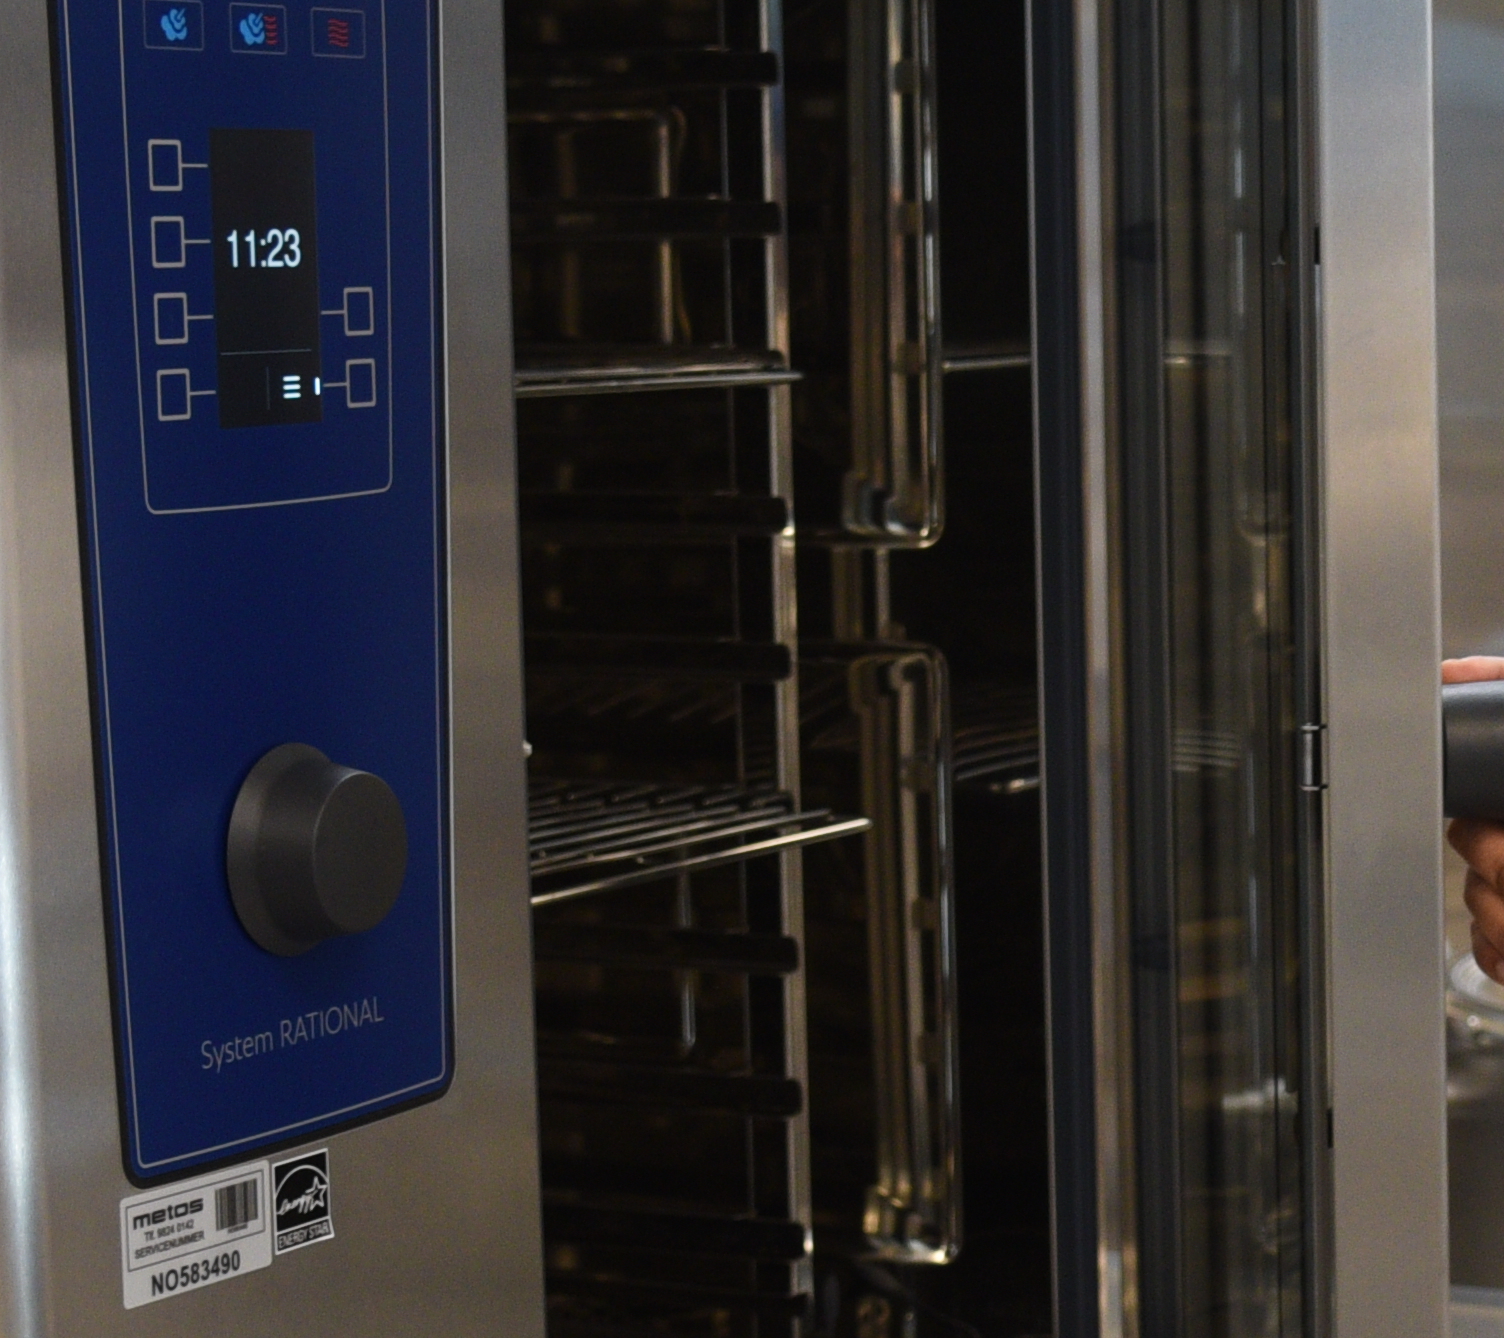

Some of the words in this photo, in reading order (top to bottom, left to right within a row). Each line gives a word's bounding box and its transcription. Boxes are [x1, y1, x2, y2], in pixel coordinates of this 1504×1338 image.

[226, 228, 302, 268] 11:23
[201, 1031, 274, 1074] System
[279, 996, 385, 1048] RATIONAL
[132, 1198, 204, 1231] metos
[176, 1219, 195, 1234] 0142
[134, 1230, 205, 1261] SERVICENUMMER
[278, 1226, 307, 1249] ENERGY
[308, 1222, 330, 1242] STAR
[151, 1249, 241, 1298] NO583490
